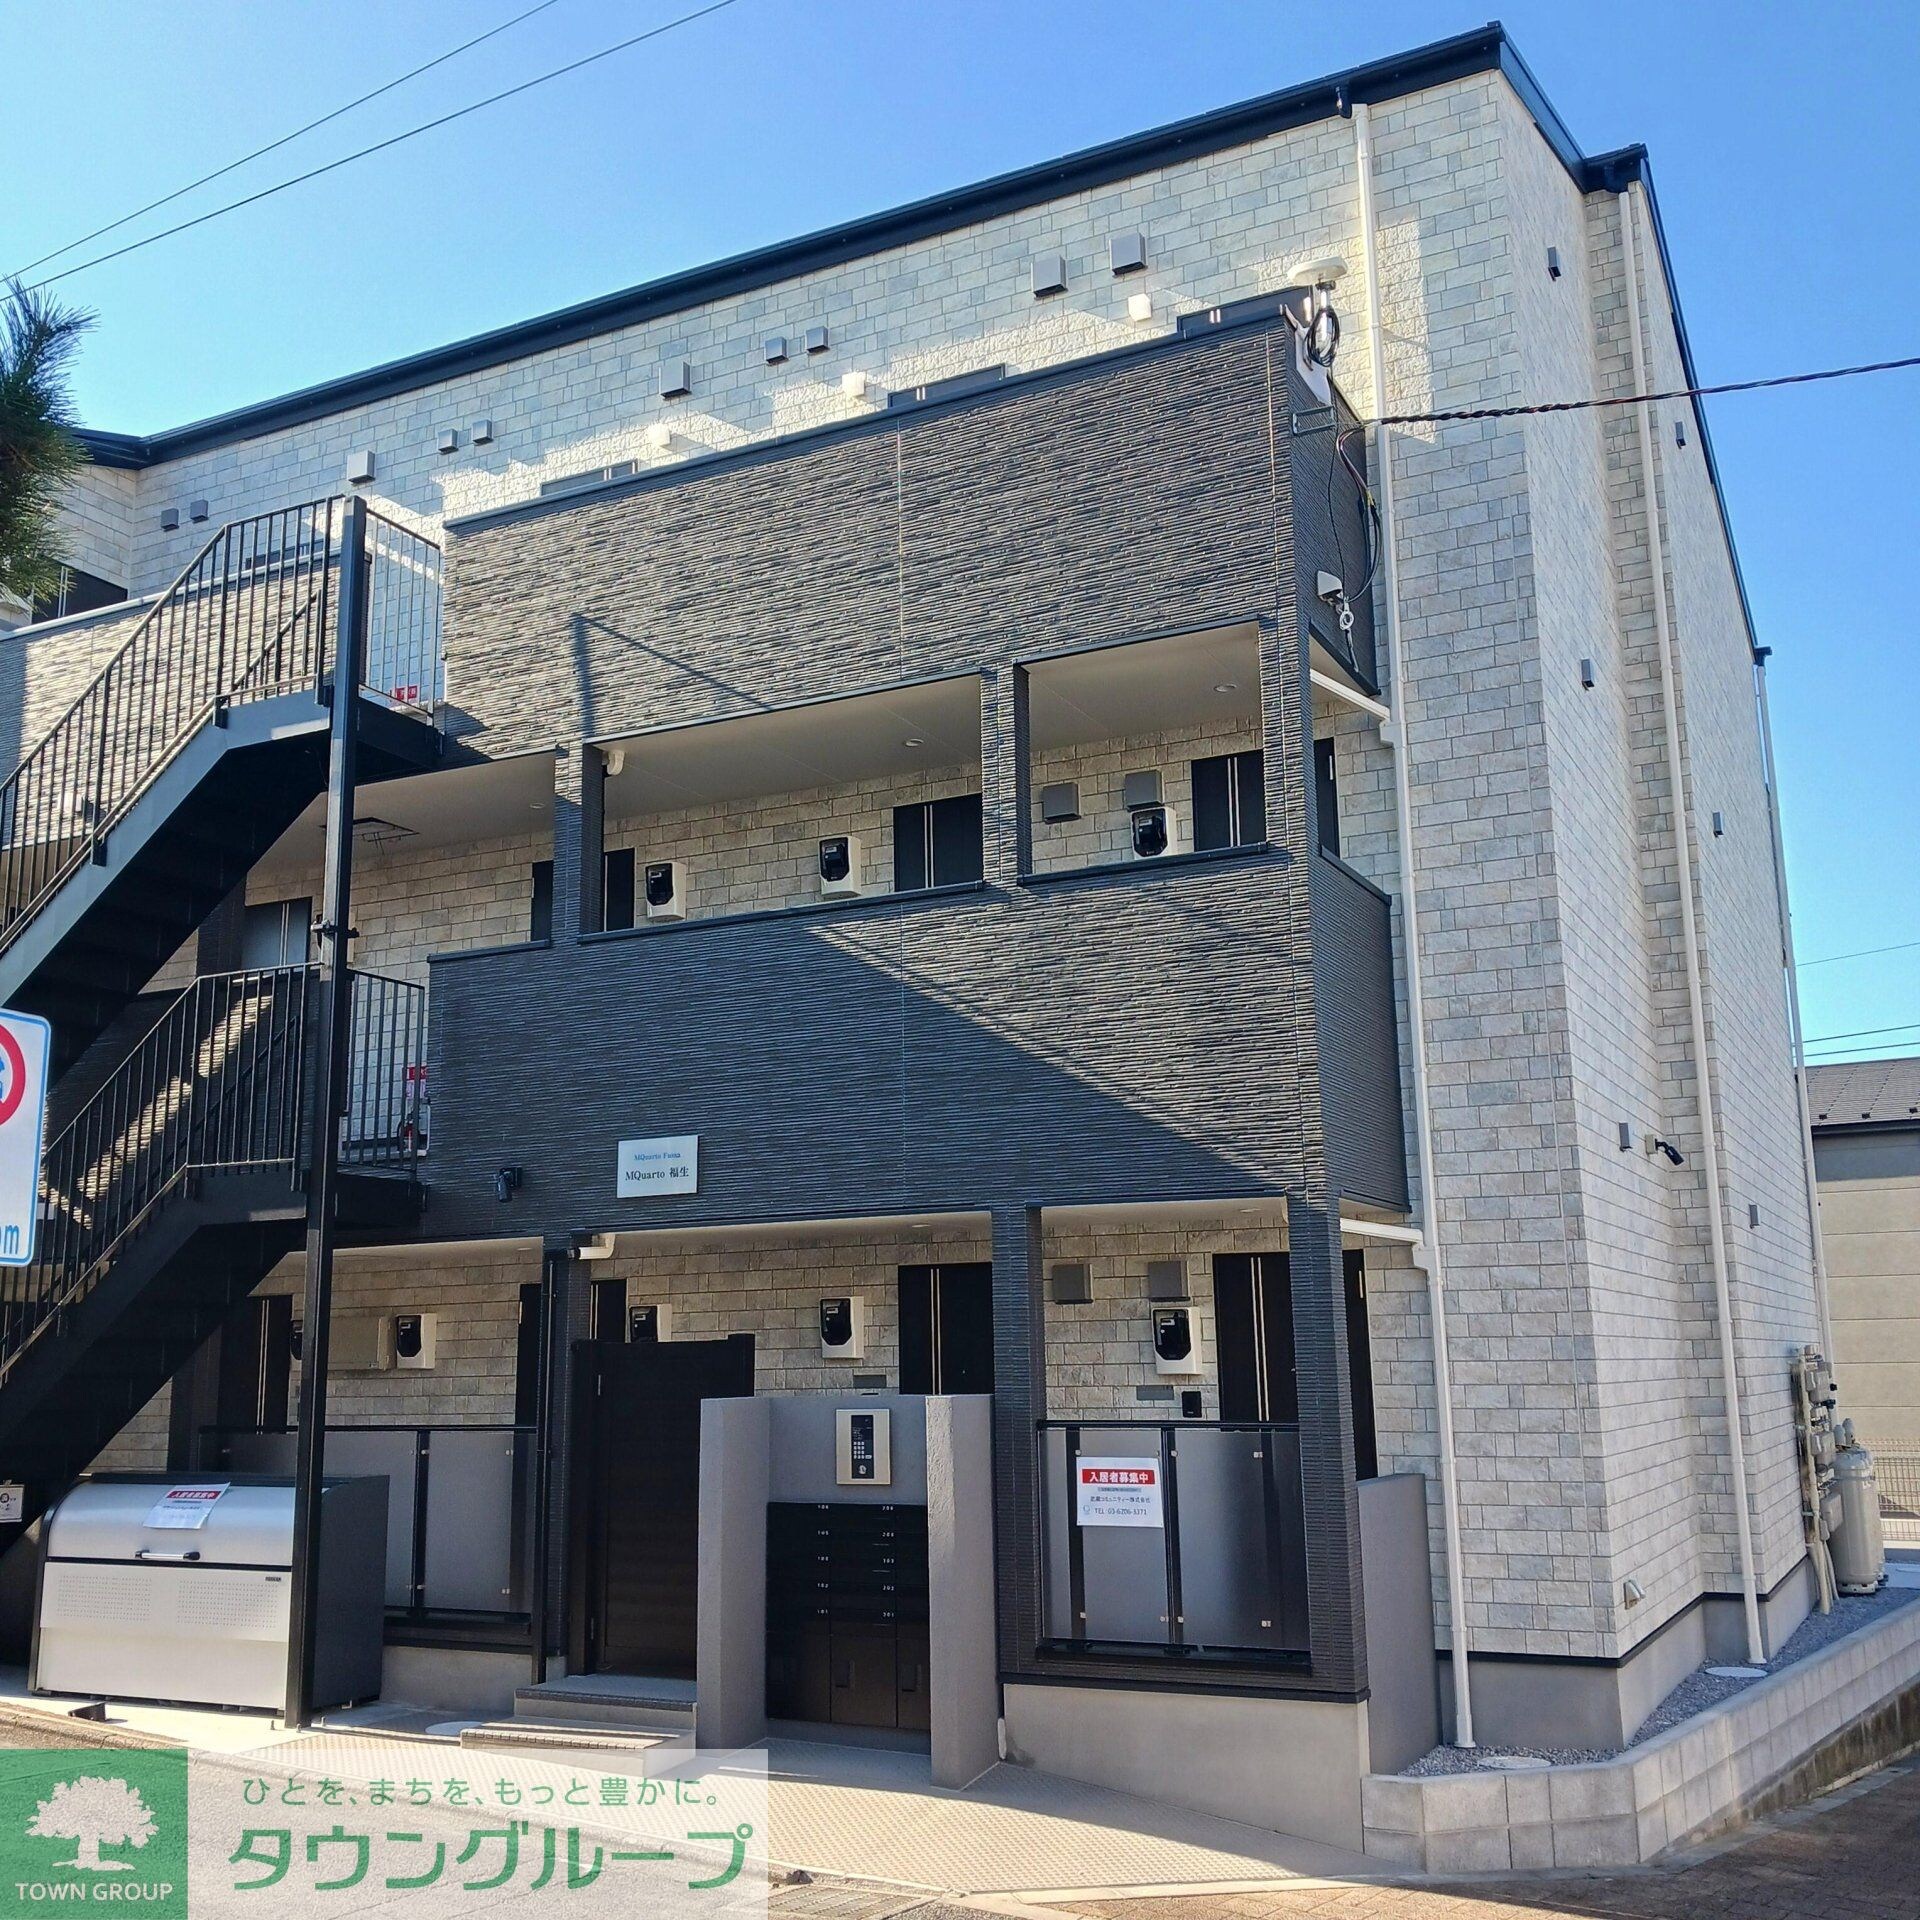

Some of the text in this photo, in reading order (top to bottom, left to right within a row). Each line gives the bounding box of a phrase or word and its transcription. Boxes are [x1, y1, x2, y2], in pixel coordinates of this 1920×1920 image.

[625, 1165, 689, 1181] MQuarto 福生
[1089, 1471, 1149, 1484] 入居者募集中
